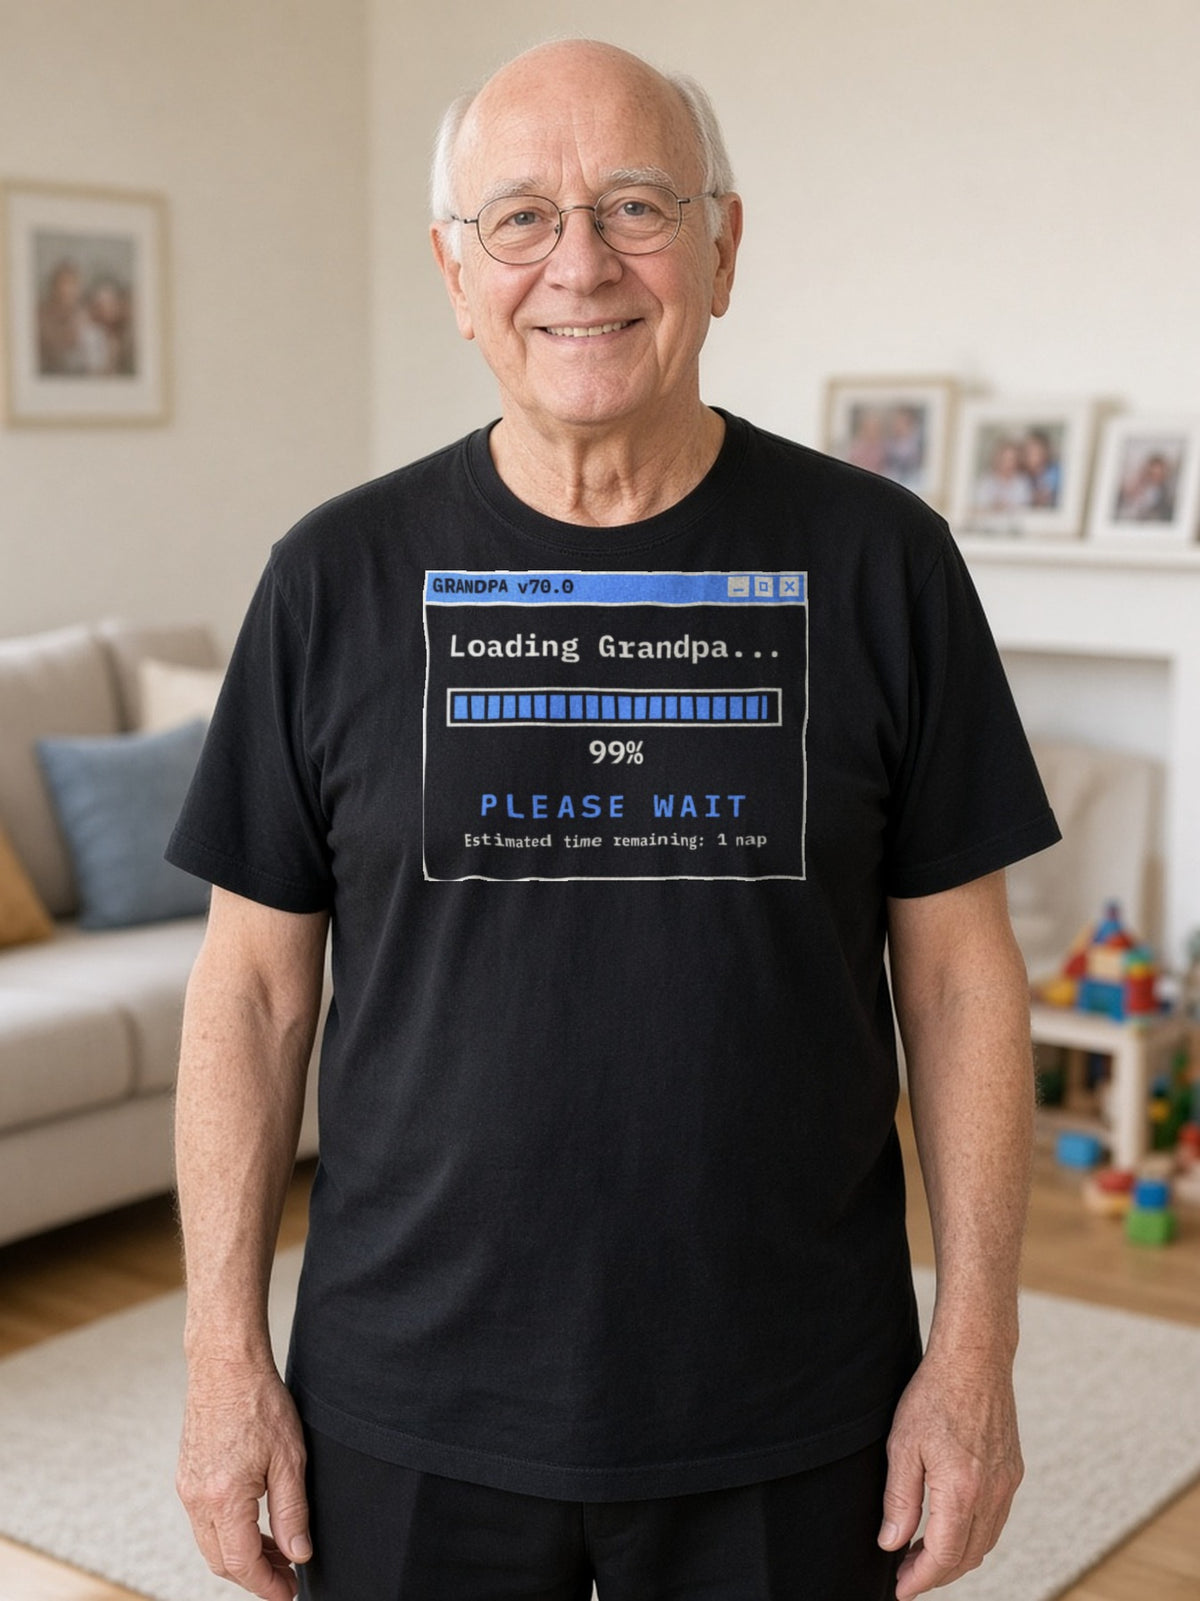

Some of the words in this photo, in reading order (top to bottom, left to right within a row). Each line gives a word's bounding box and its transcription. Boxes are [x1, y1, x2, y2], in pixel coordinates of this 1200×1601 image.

[432, 577, 508, 594] GRANDPA
[518, 578, 574, 595] v70.0
[450, 634, 580, 663] Loading
[599, 635, 779, 664] Grandpa...
[588, 740, 644, 765] 99%
[480, 793, 624, 819] PLEASE
[653, 794, 746, 818] WAIT
[464, 833, 552, 848] Estimated
[564, 834, 602, 848] time
[614, 832, 704, 850] remaining:
[717, 833, 727, 846] 1
[736, 834, 767, 850] nap
